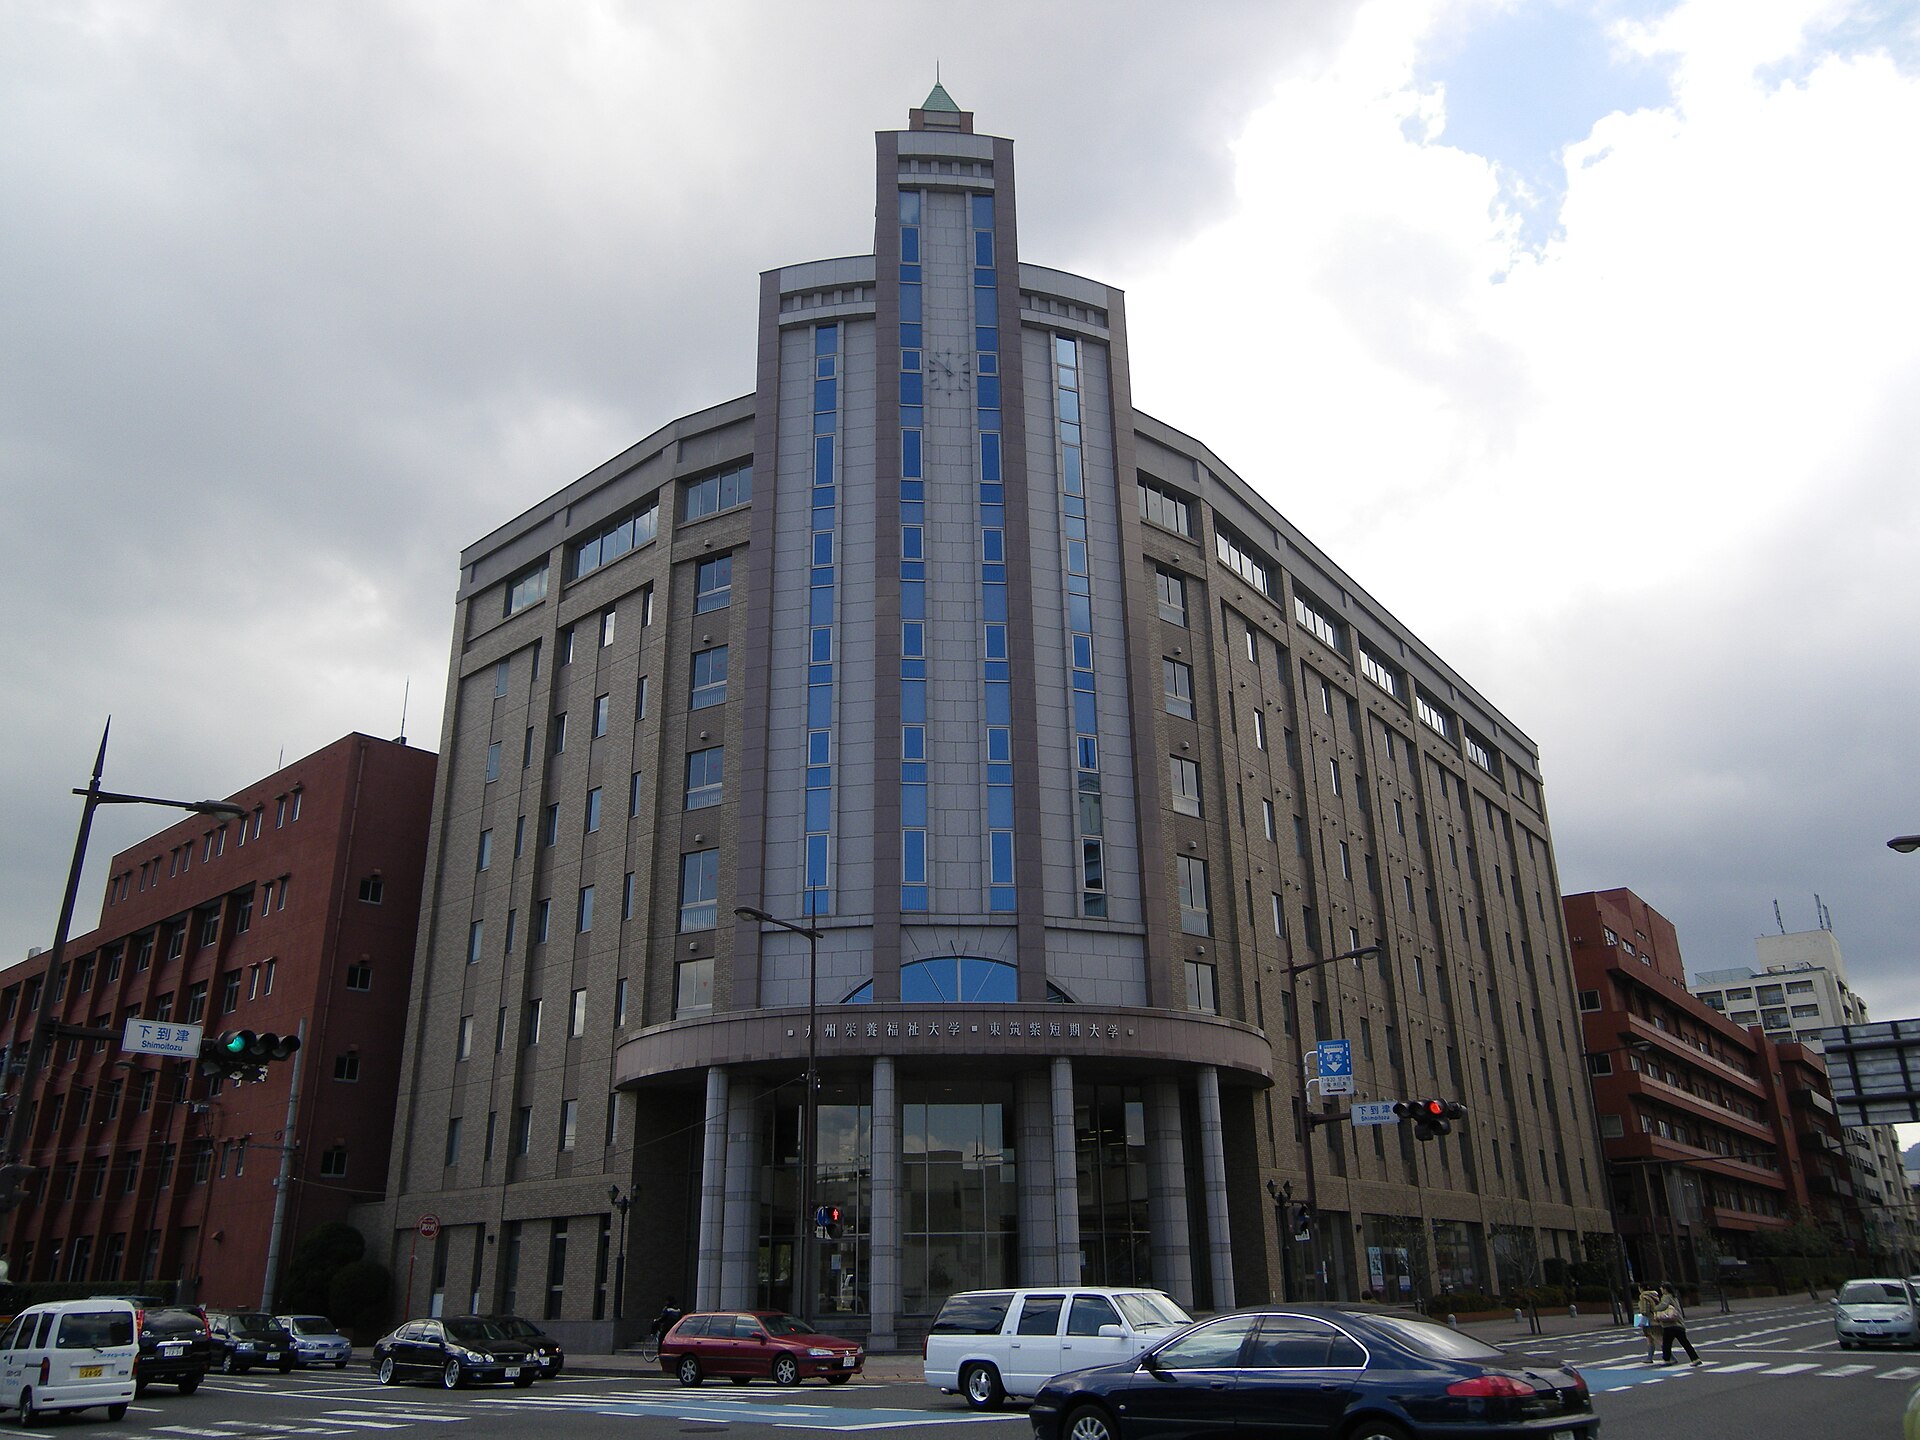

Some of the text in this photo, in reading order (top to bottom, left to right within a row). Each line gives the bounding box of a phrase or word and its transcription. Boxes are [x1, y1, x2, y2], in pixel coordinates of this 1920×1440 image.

[139, 1024, 190, 1043] 下到津
[990, 1022, 1119, 1039] 東筑紫短期大学
[141, 1040, 183, 1052] Shimoitozu
[1357, 1104, 1391, 1115] 下到津
